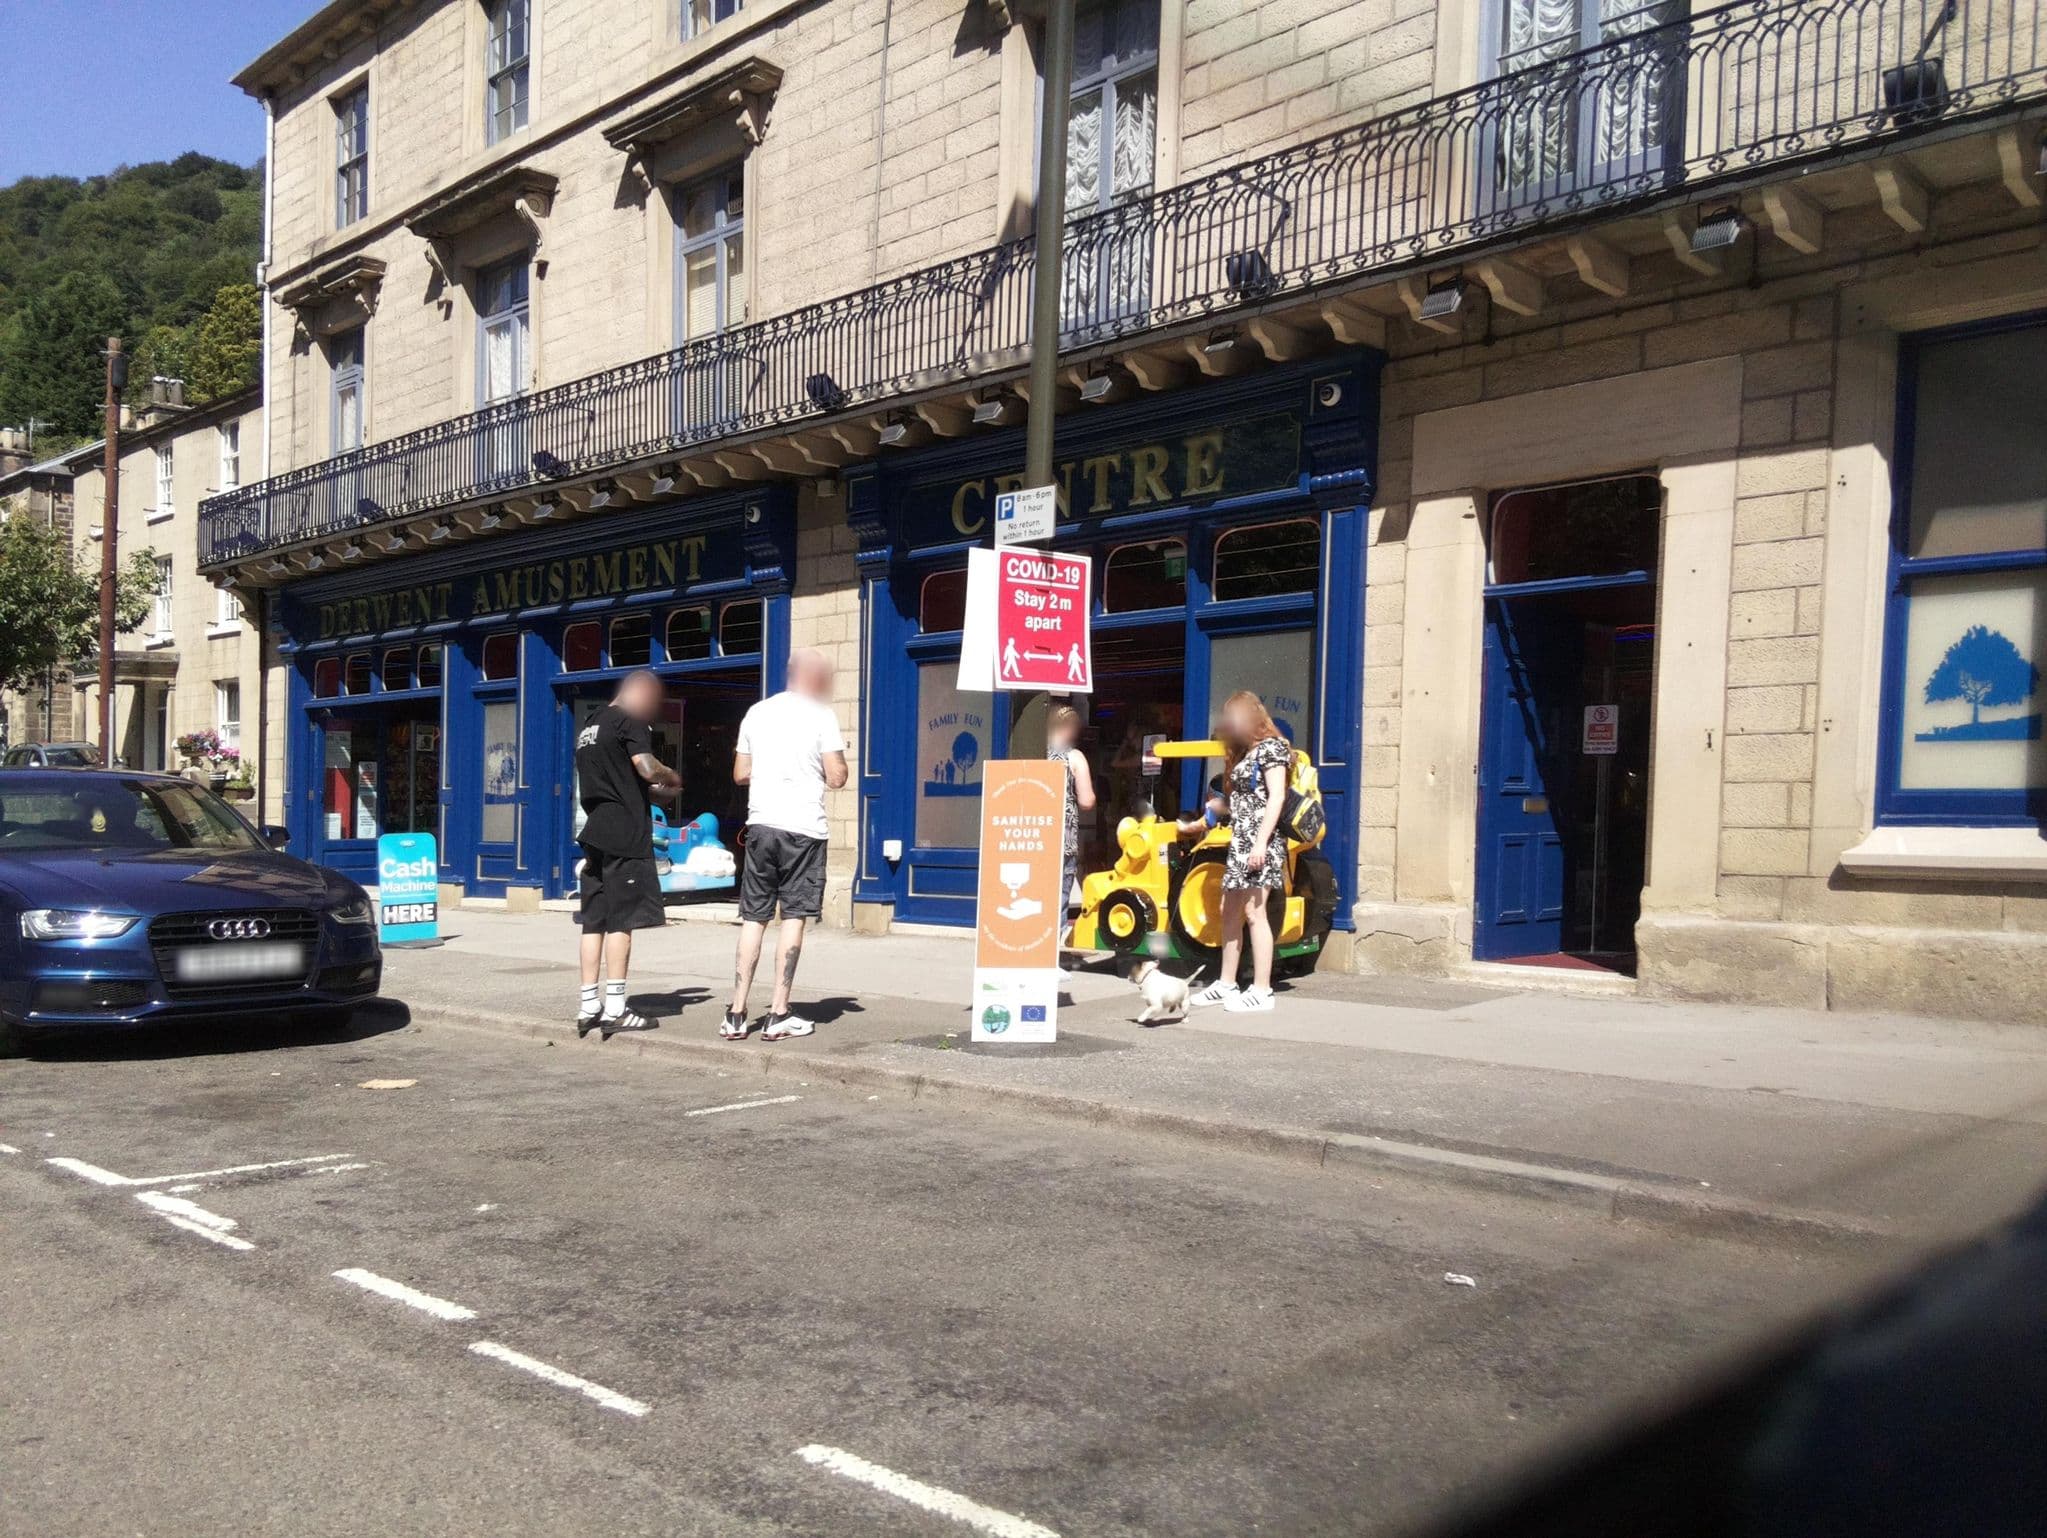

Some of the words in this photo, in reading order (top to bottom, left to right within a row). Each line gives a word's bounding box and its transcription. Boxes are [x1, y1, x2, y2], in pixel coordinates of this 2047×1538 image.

[1001, 498, 1013, 519] P
[1028, 503, 1044, 512] hour
[1019, 520, 1040, 529] return
[1003, 531, 1022, 541] within
[1028, 528, 1044, 536] hour
[1007, 558, 1081, 584] COVID-19
[319, 582, 453, 639] DERWENT
[472, 536, 706, 615] AMUSEMENT
[1014, 589, 1046, 611] Stay
[1025, 615, 1062, 632] apart
[1274, 696, 1301, 712] FUN
[928, 711, 959, 731] FAMILY
[963, 713, 984, 728] FUN
[992, 815, 1054, 826] SANITISE
[1004, 828, 1041, 839] YOUR
[999, 841, 1044, 851] HANDS
[379, 857, 437, 879] Cash
[381, 881, 437, 894] Machine
[382, 903, 435, 925] HERE
